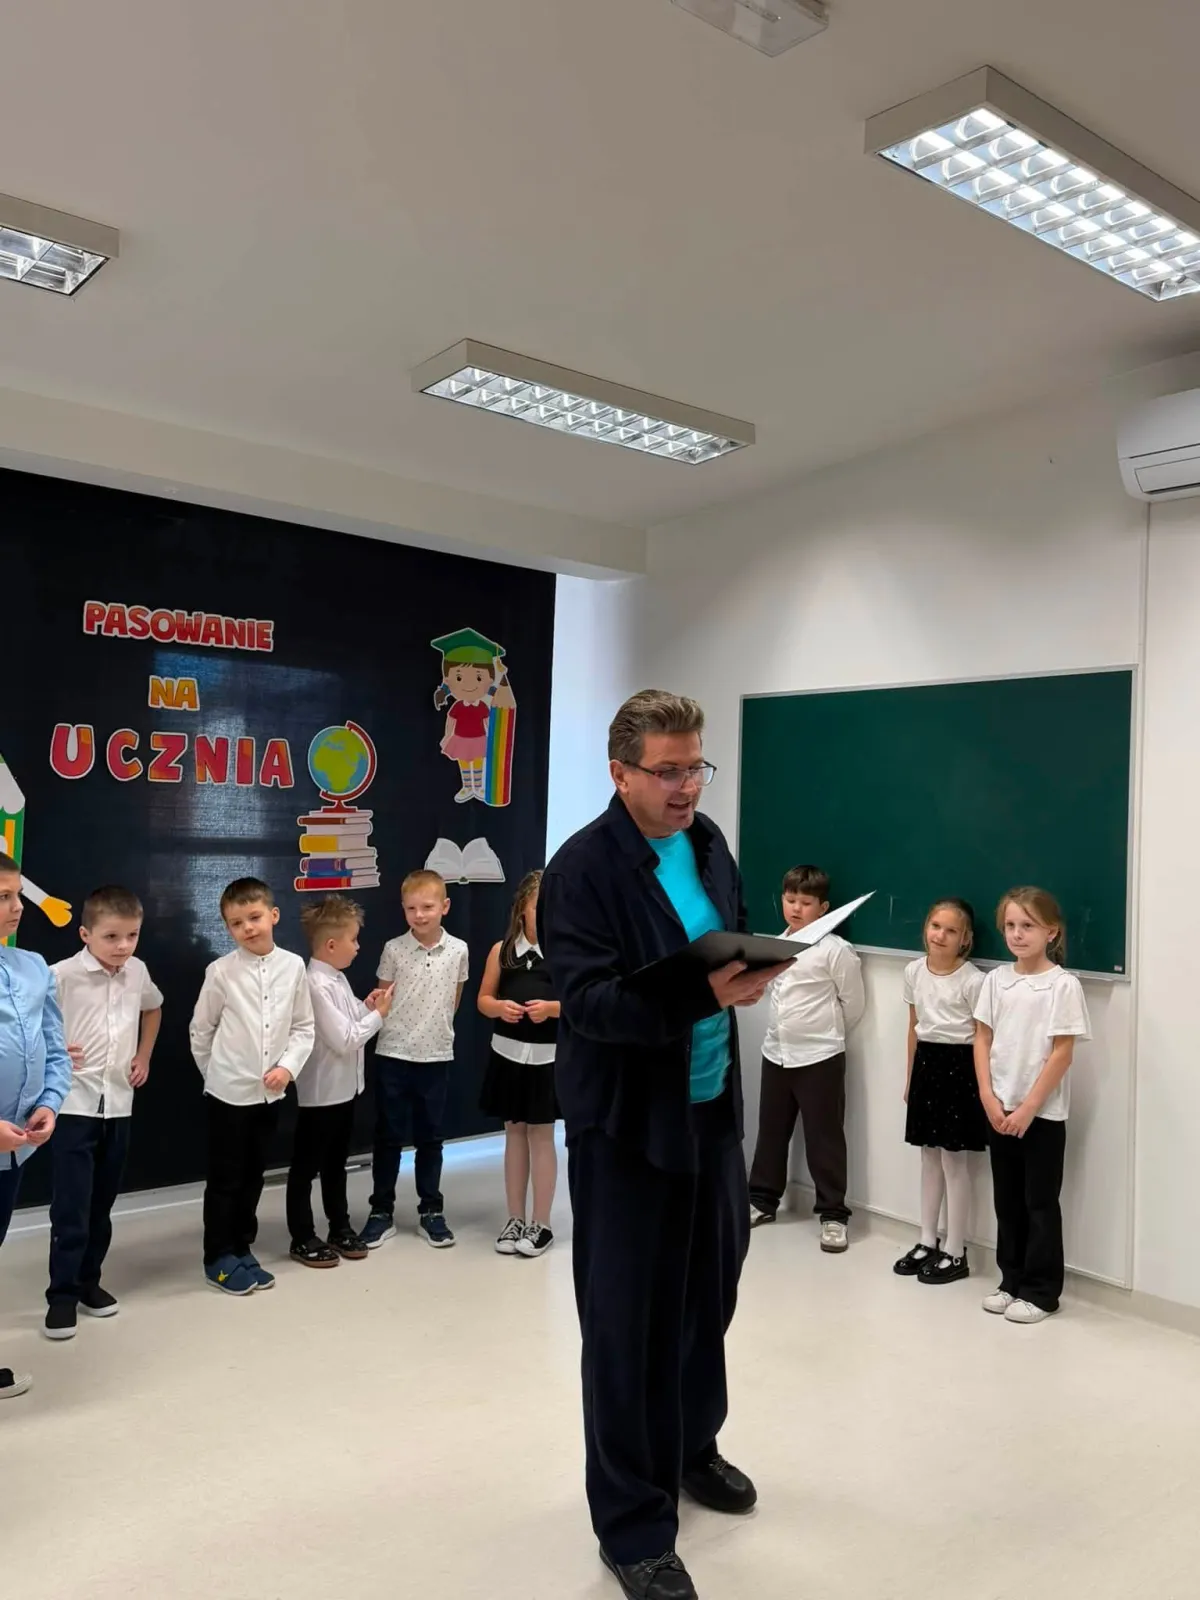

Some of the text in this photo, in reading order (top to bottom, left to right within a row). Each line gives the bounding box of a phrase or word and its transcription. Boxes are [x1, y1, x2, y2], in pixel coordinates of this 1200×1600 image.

[83, 601, 274, 651] PASOWANIE
[149, 676, 199, 710] NA
[50, 724, 294, 788] UCZNIA
